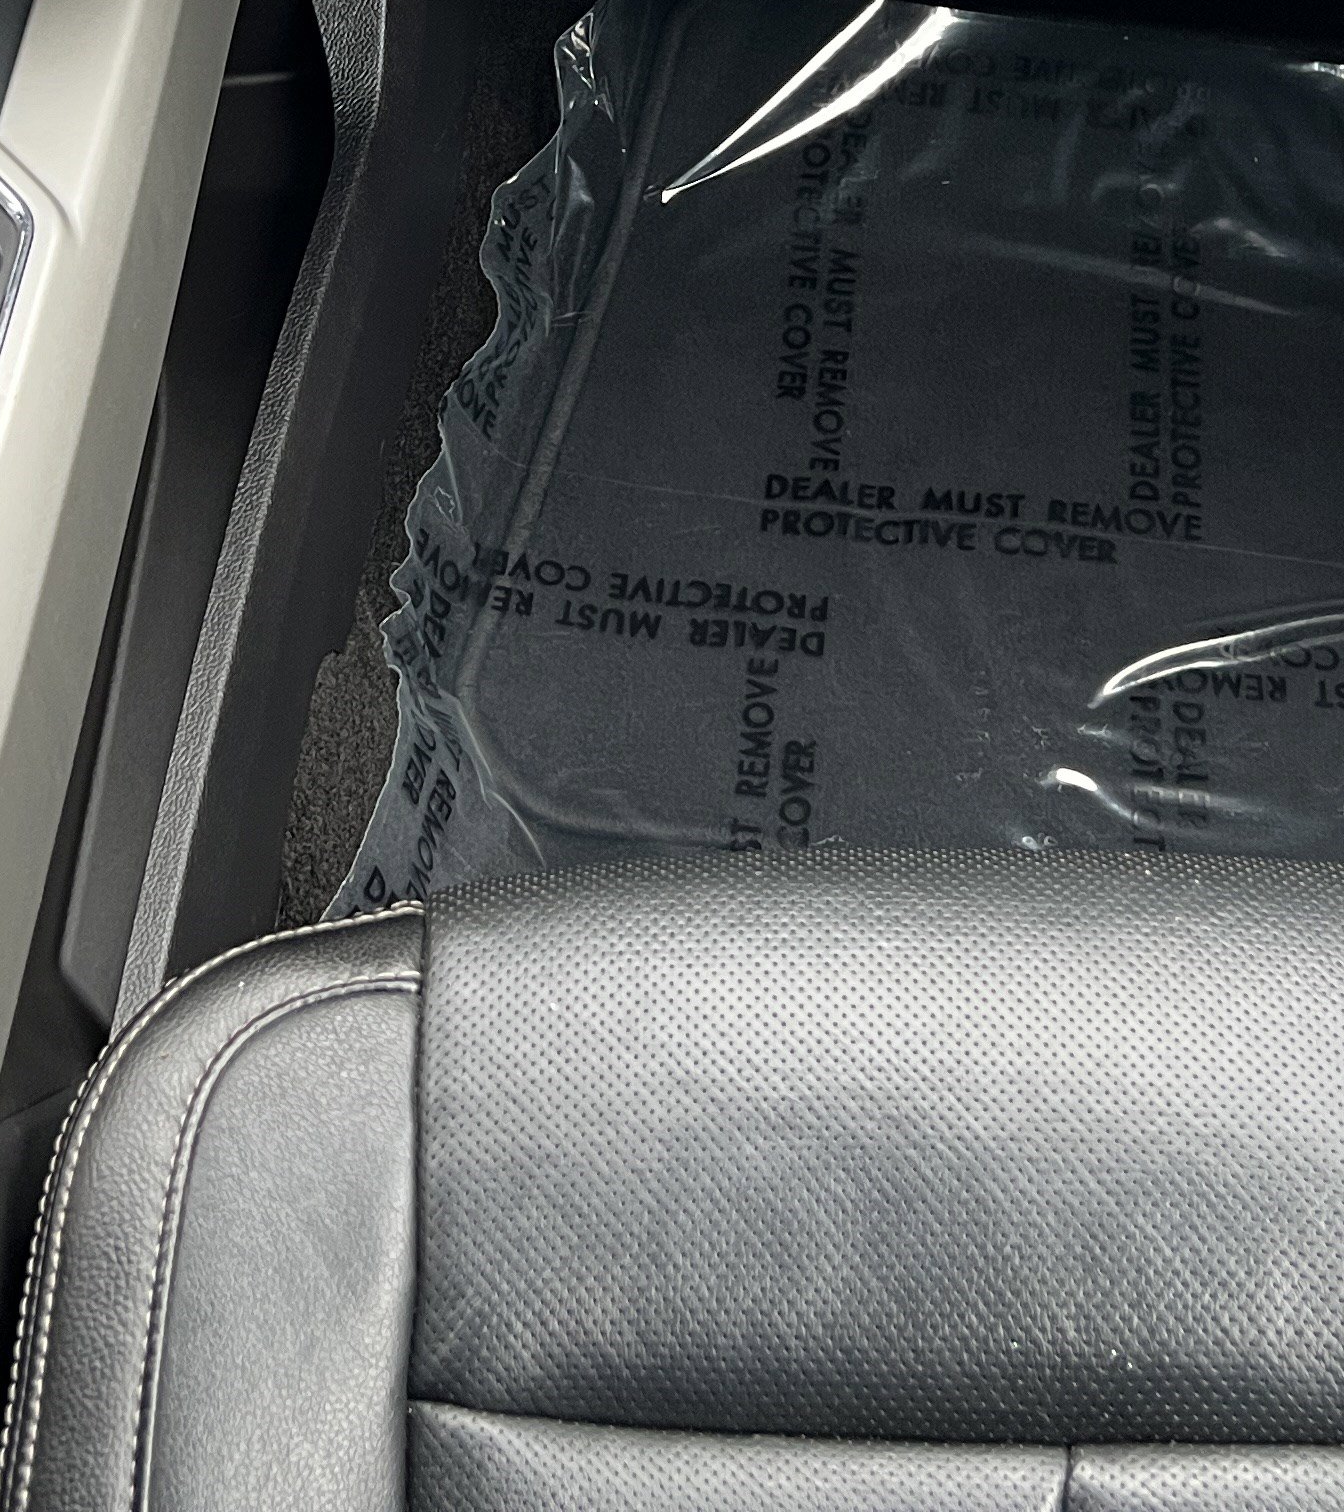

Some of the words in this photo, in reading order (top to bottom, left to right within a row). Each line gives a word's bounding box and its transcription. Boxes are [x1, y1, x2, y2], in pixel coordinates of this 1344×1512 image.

[787, 128, 834, 292] OTECTIVE
[822, 246, 861, 335] MUST
[1128, 293, 1161, 373] MUST
[774, 301, 815, 402] COVER
[807, 348, 851, 472] REMOVE
[1128, 390, 1160, 502] DEALER
[1170, 335, 1202, 508] PROTECTIVE
[759, 509, 977, 551] PROTECTIVE
[995, 526, 1118, 566] COVER
[764, 474, 897, 513] DEALER
[921, 486, 1026, 519] MUST
[1047, 497, 1204, 543] REMOVE
[556, 600, 662, 641] MUST
[609, 572, 829, 622] PROTECTIVE
[689, 618, 826, 658] DEALER
[735, 657, 781, 797] REMOVE
[1173, 701, 1210, 829] DEALR
[777, 738, 818, 850] COVER
